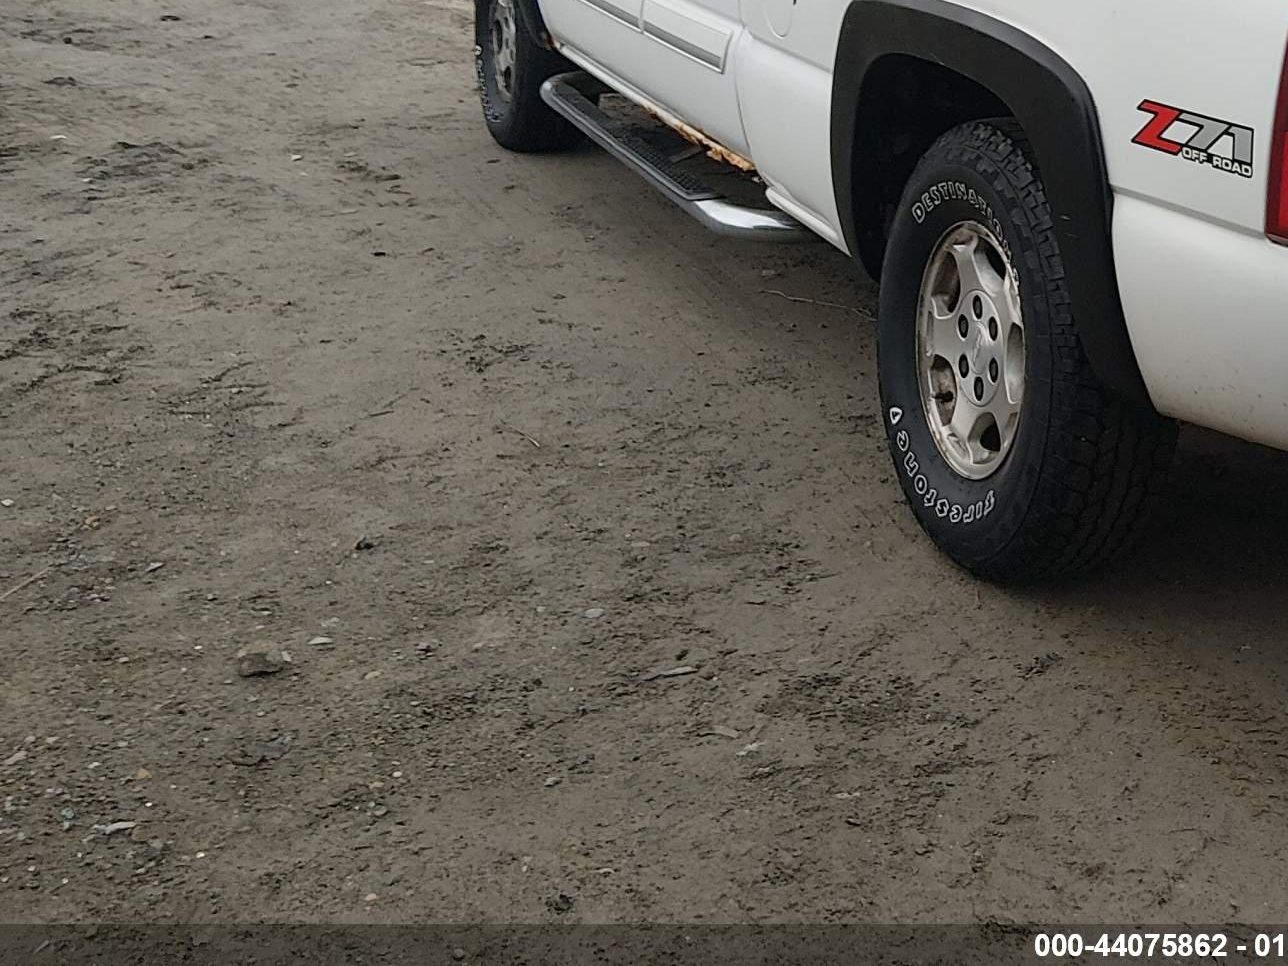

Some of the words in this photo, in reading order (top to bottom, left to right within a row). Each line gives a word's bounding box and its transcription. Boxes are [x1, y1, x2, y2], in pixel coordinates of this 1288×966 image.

[1131, 99, 1254, 165] Z71
[1182, 147, 1208, 163] OFF
[1212, 155, 1253, 178] ROAD
